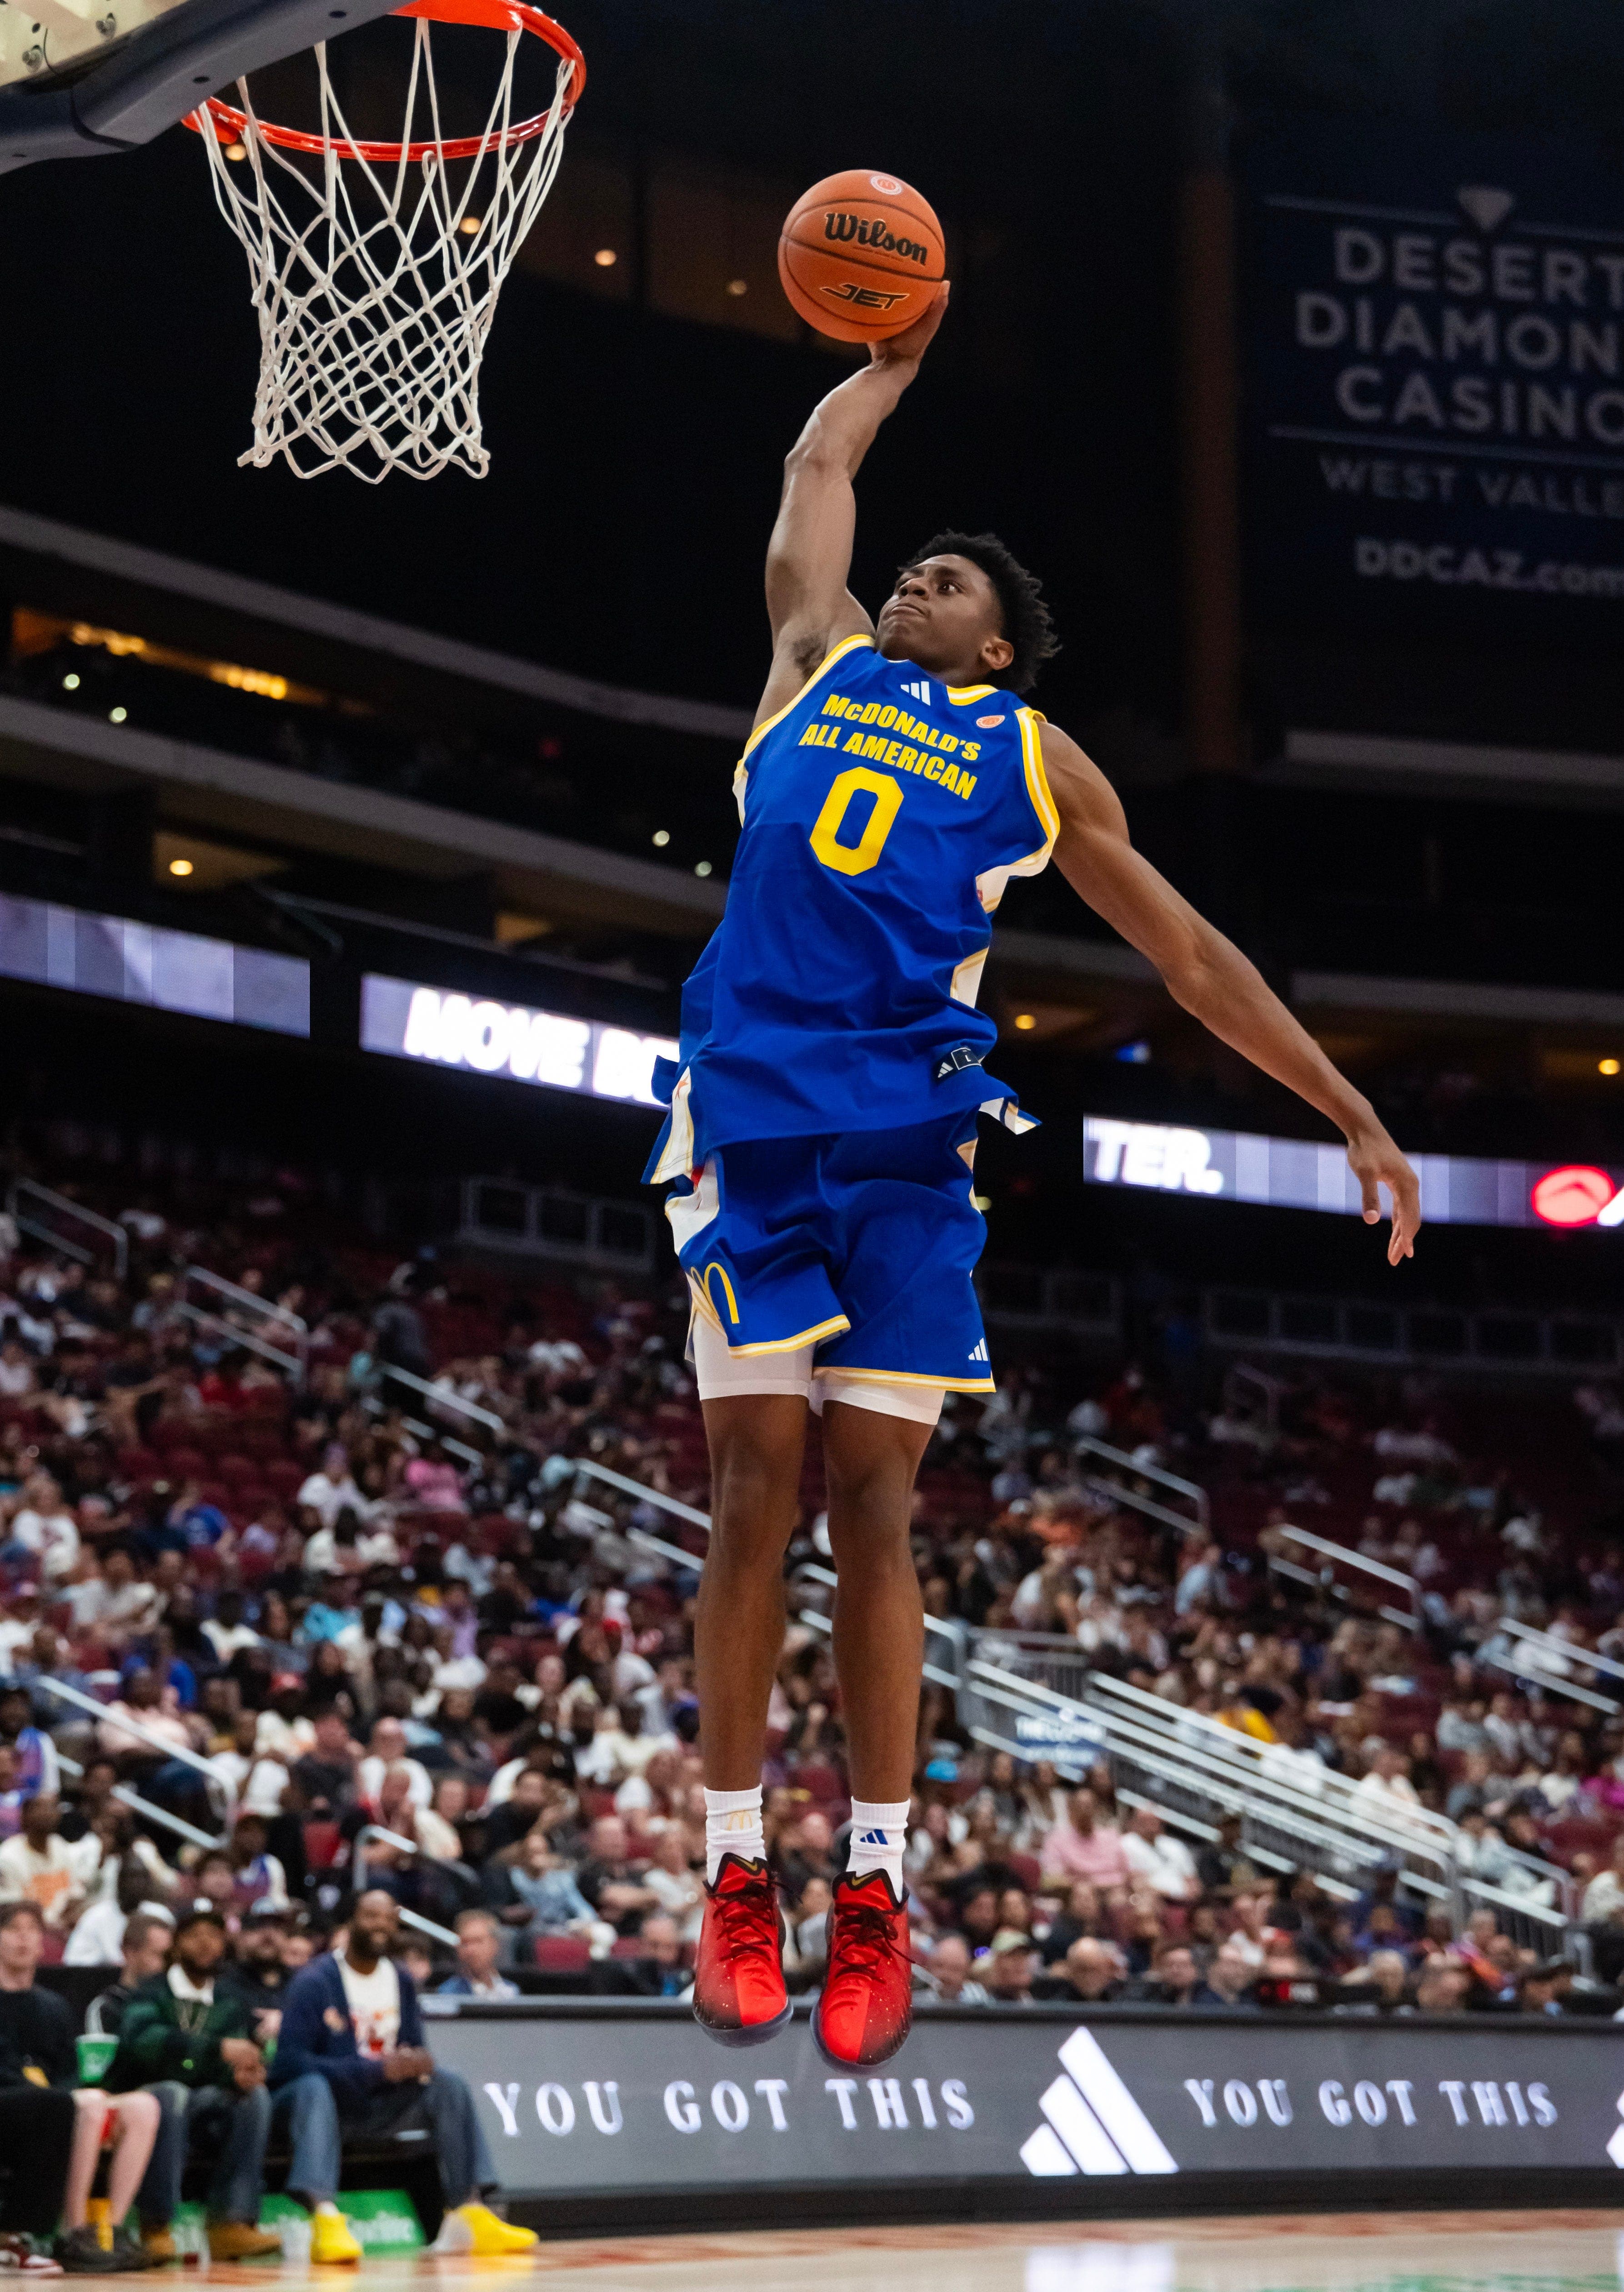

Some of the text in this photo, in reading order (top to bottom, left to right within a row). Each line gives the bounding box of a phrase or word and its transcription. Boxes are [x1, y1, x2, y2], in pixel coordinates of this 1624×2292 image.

[825, 213, 928, 267] Wilson
[1333, 225, 1624, 311] DESERT
[819, 283, 909, 311] JET
[1294, 290, 1624, 377] DIAMON
[1335, 365, 1624, 445] CASINO
[1318, 456, 1456, 502] WEST
[798, 724, 978, 800] ALL AMERICAN
[821, 694, 982, 761] McDONALD'S
[809, 766, 904, 876] 0
[404, 987, 590, 1088] MOVE
[1088, 1117, 1223, 1194] TER.
[484, 2077, 975, 2136] YOU GOT THIS
[1183, 2079, 1558, 2127] YOU GOT THIS
